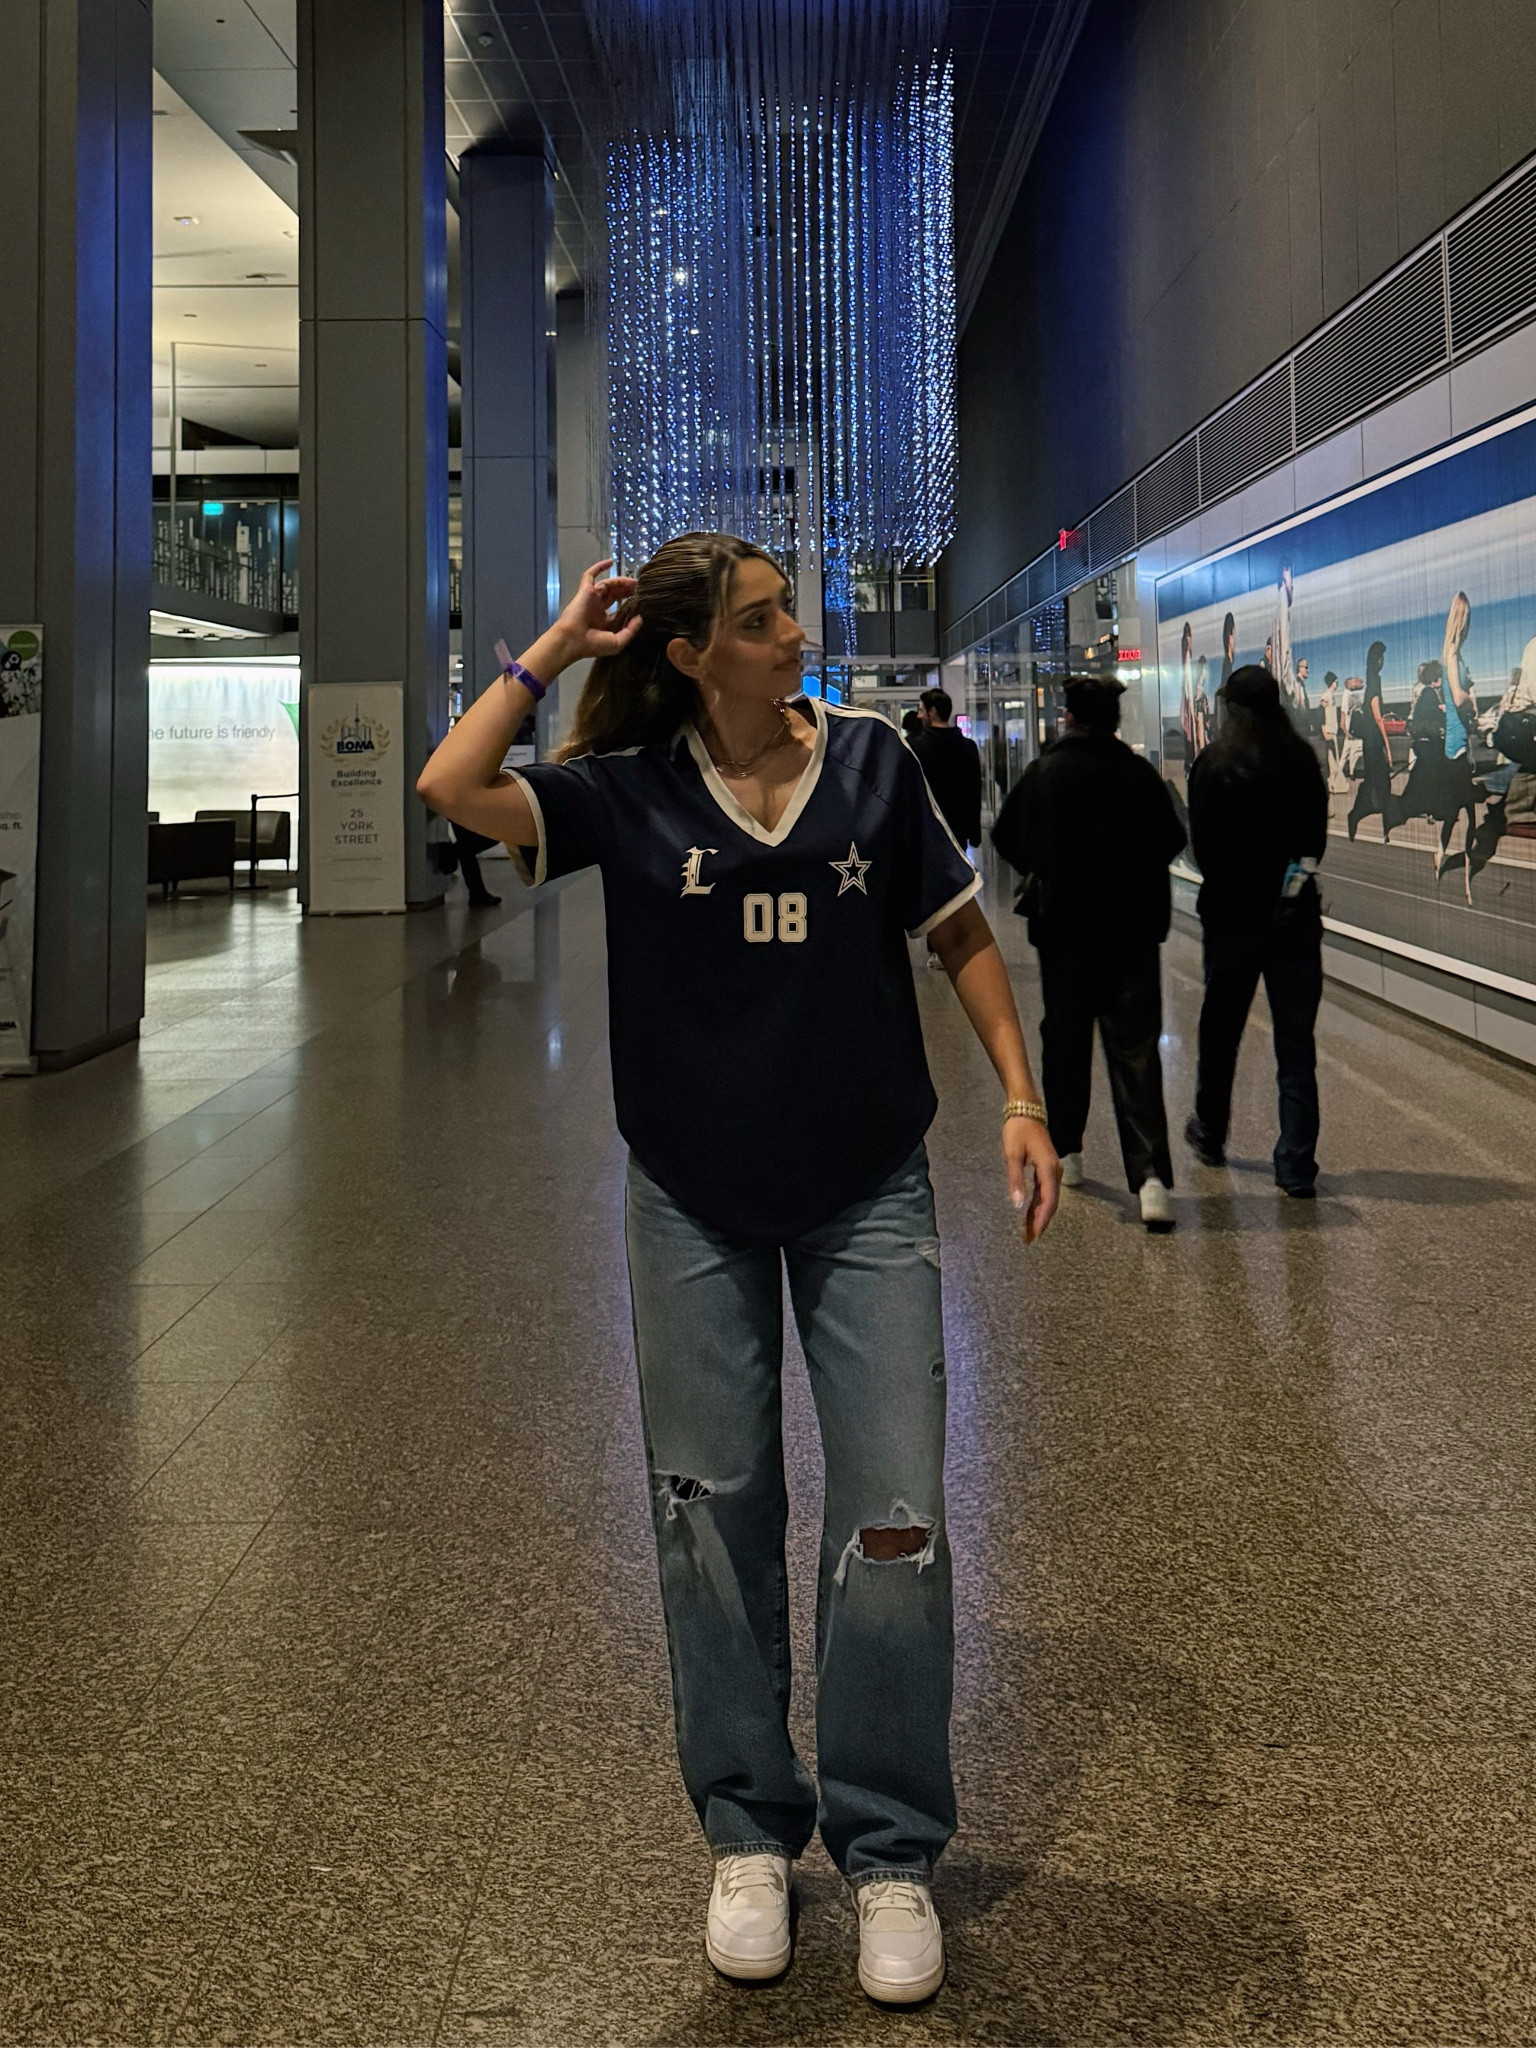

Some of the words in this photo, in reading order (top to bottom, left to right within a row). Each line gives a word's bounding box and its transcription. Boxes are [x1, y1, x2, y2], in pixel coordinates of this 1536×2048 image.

[170, 725, 213, 739] future
[217, 725, 229, 739] is
[232, 724, 276, 741] friendly
[336, 740, 375, 752] BOMA
[336, 770, 377, 779] Building
[331, 778, 382, 787] Excellence
[350, 808, 364, 818] 25
[341, 820, 374, 831] YORK
[334, 833, 379, 845] STREET
[680, 846, 720, 898] L
[743, 892, 808, 943] 08
